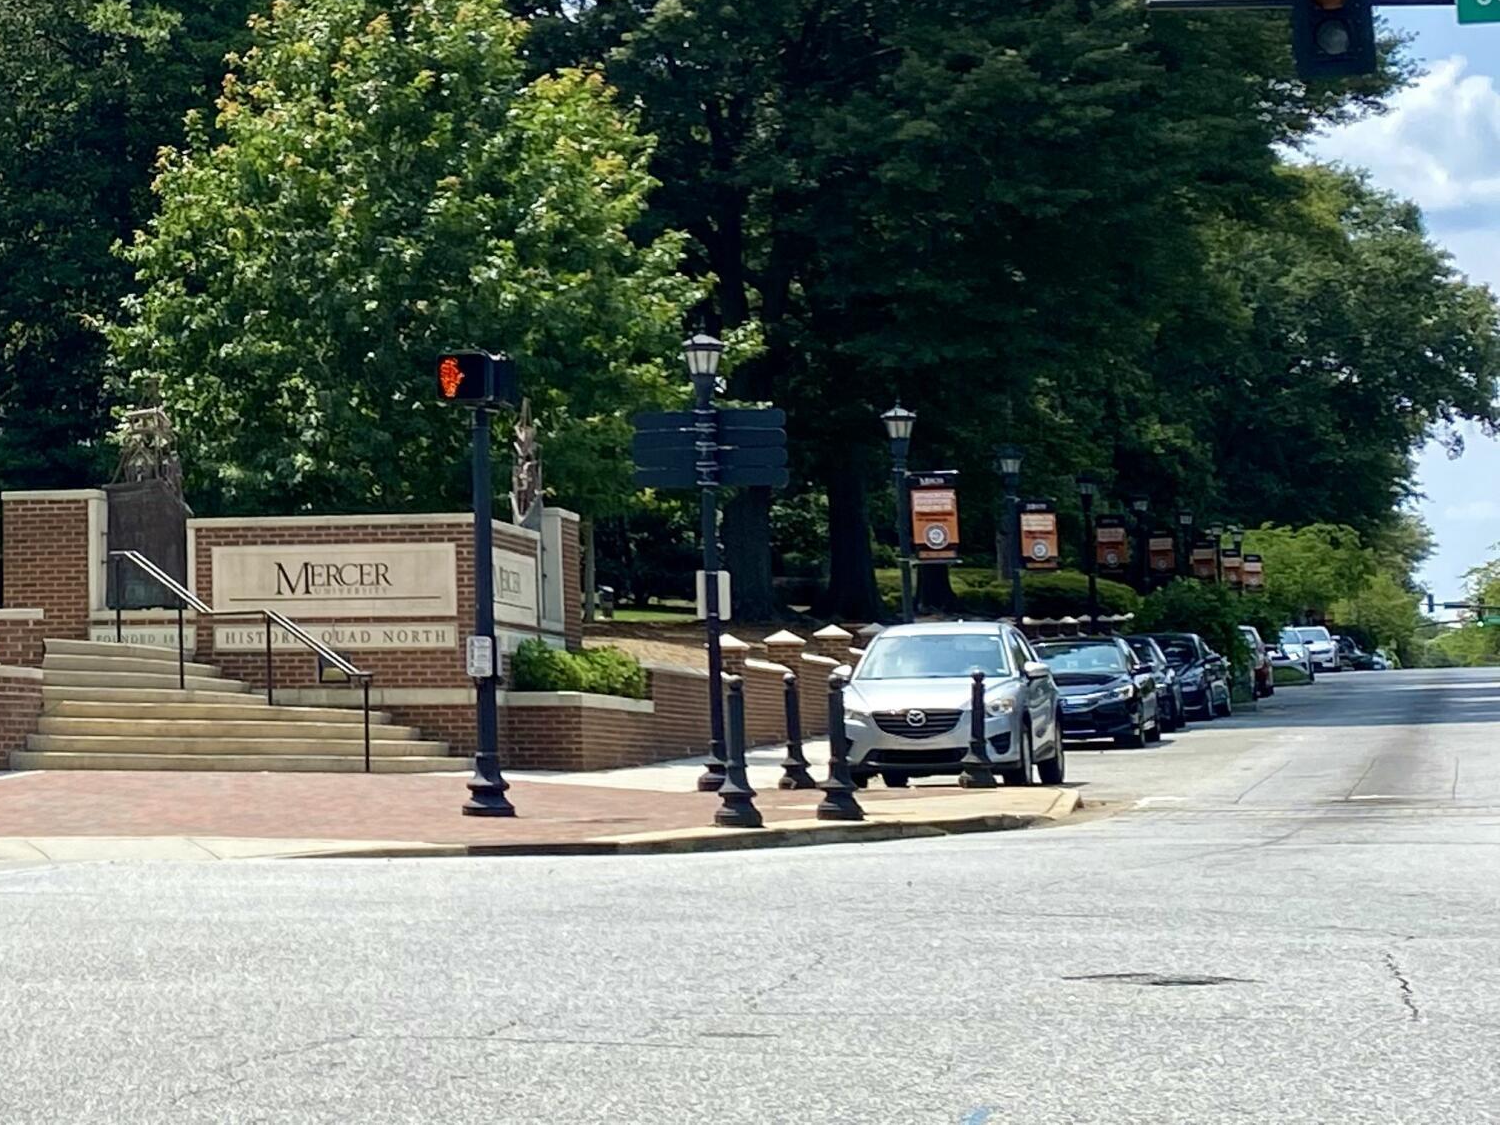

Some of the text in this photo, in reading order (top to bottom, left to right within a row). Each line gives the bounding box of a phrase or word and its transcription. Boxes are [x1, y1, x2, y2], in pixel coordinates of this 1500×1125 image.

[274, 561, 393, 596] MERCER
[313, 586, 388, 596] UNIVERSITY
[163, 633, 189, 644] 183
[225, 629, 446, 645] HISTOR QUAD NORTH
